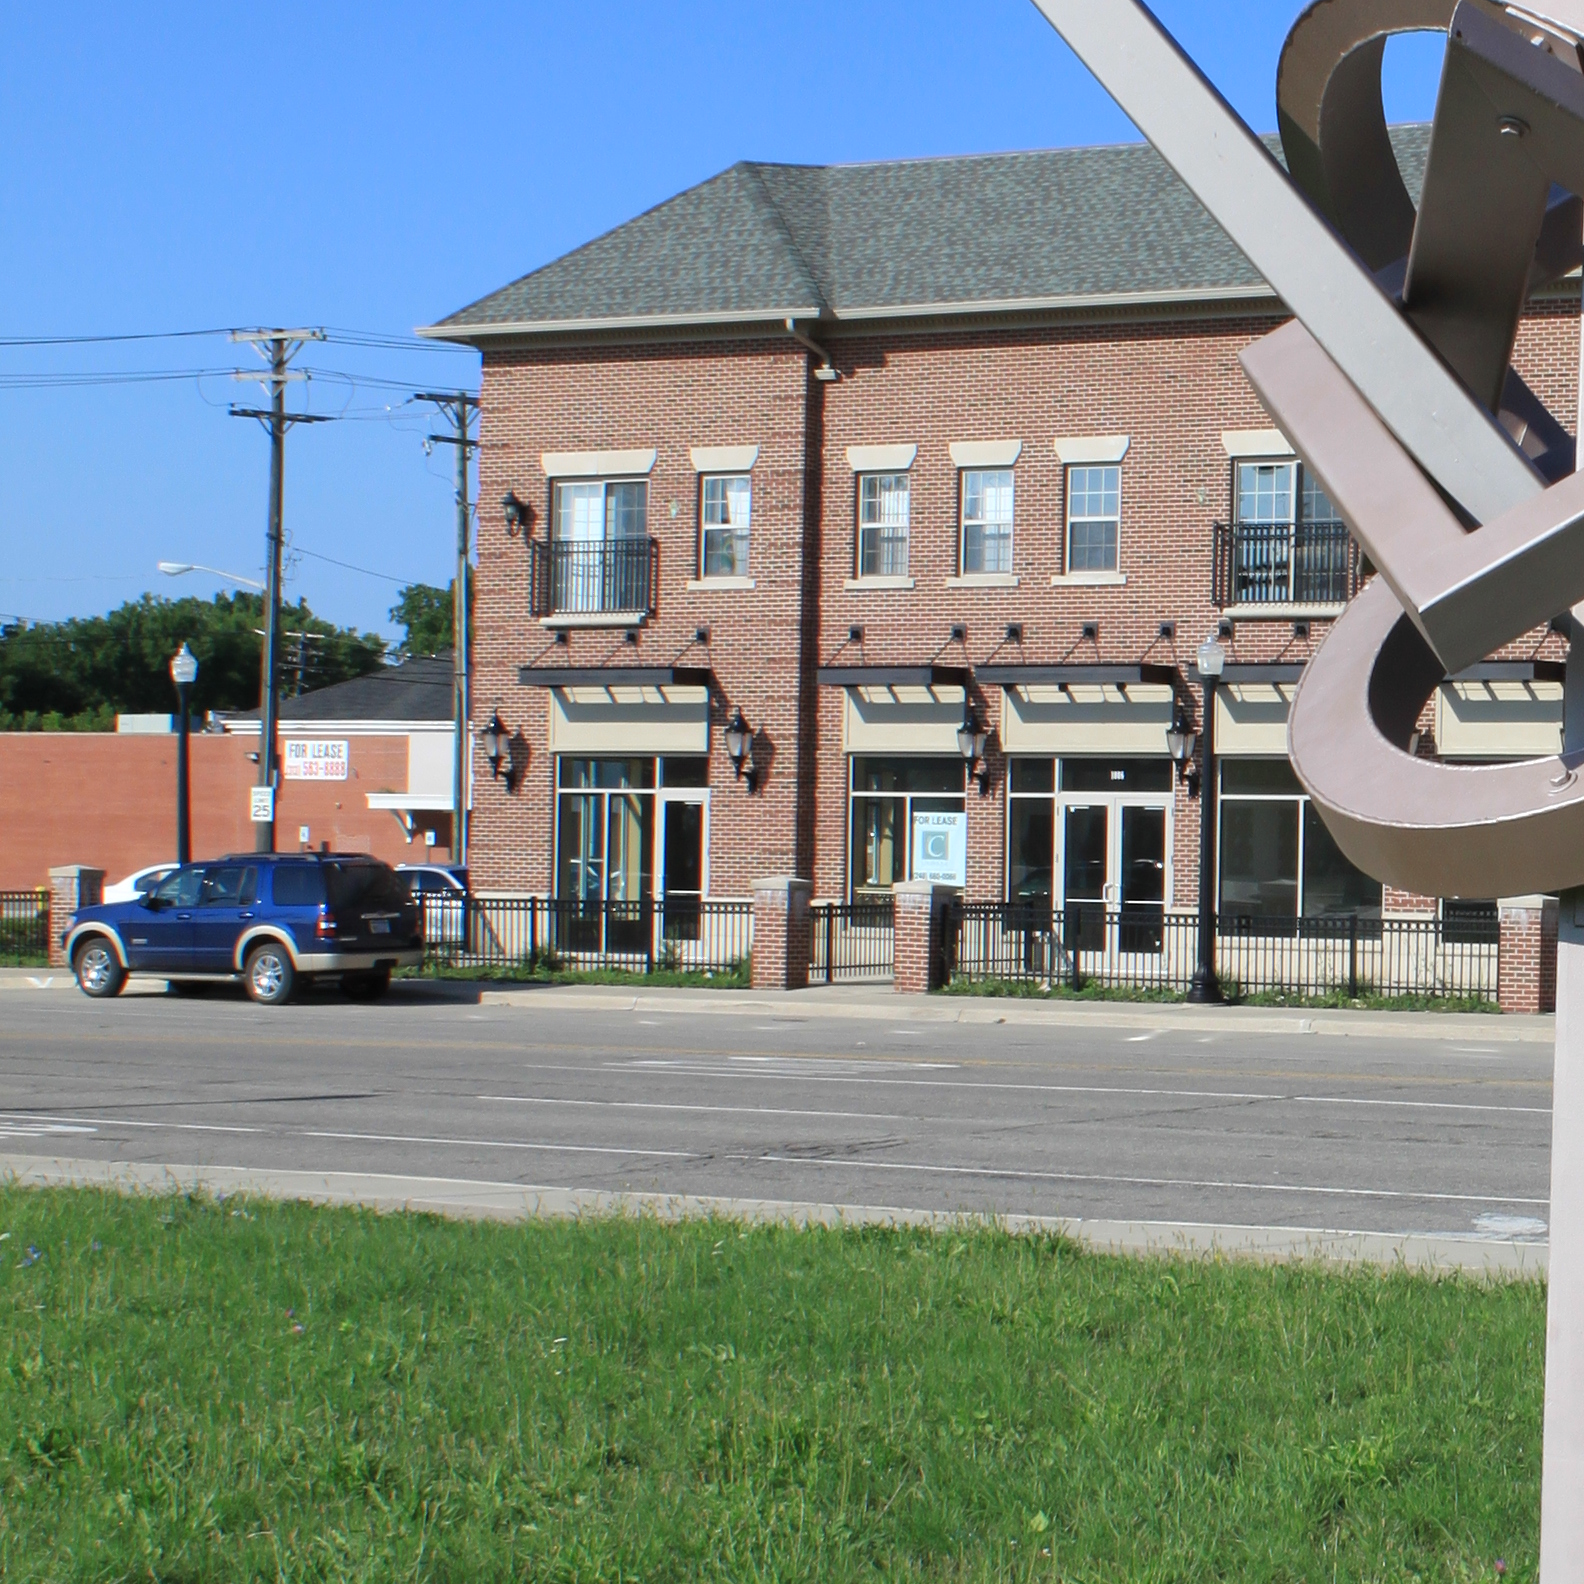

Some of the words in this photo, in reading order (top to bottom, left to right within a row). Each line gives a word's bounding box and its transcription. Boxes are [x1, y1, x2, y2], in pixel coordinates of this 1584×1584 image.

[289, 743, 307, 758] FOR
[312, 743, 343, 758] LEASE
[252, 804, 270, 818] 25
[914, 816, 930, 825] FOR
[932, 816, 958, 826] LEASE
[927, 835, 945, 857] C
